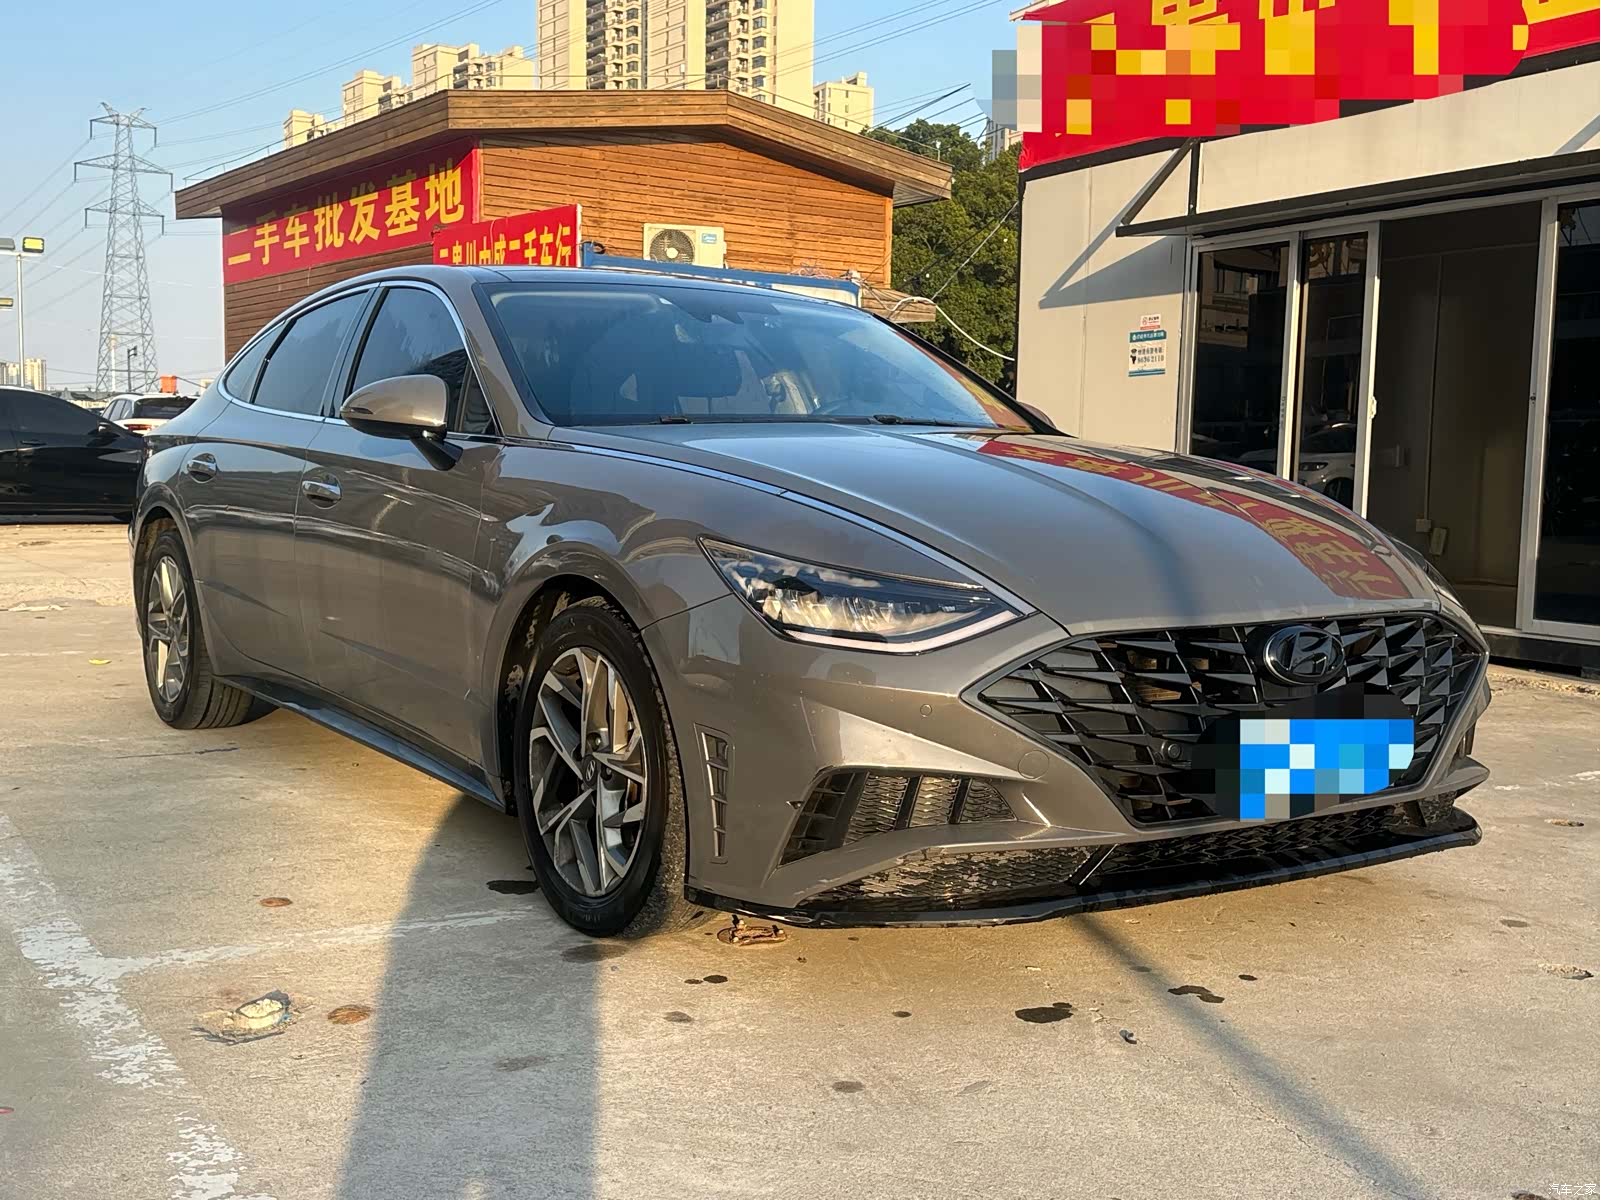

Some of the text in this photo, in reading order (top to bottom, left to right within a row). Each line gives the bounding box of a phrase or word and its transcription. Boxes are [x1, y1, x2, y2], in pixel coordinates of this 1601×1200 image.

[228, 158, 466, 267] 二手车批发基地
